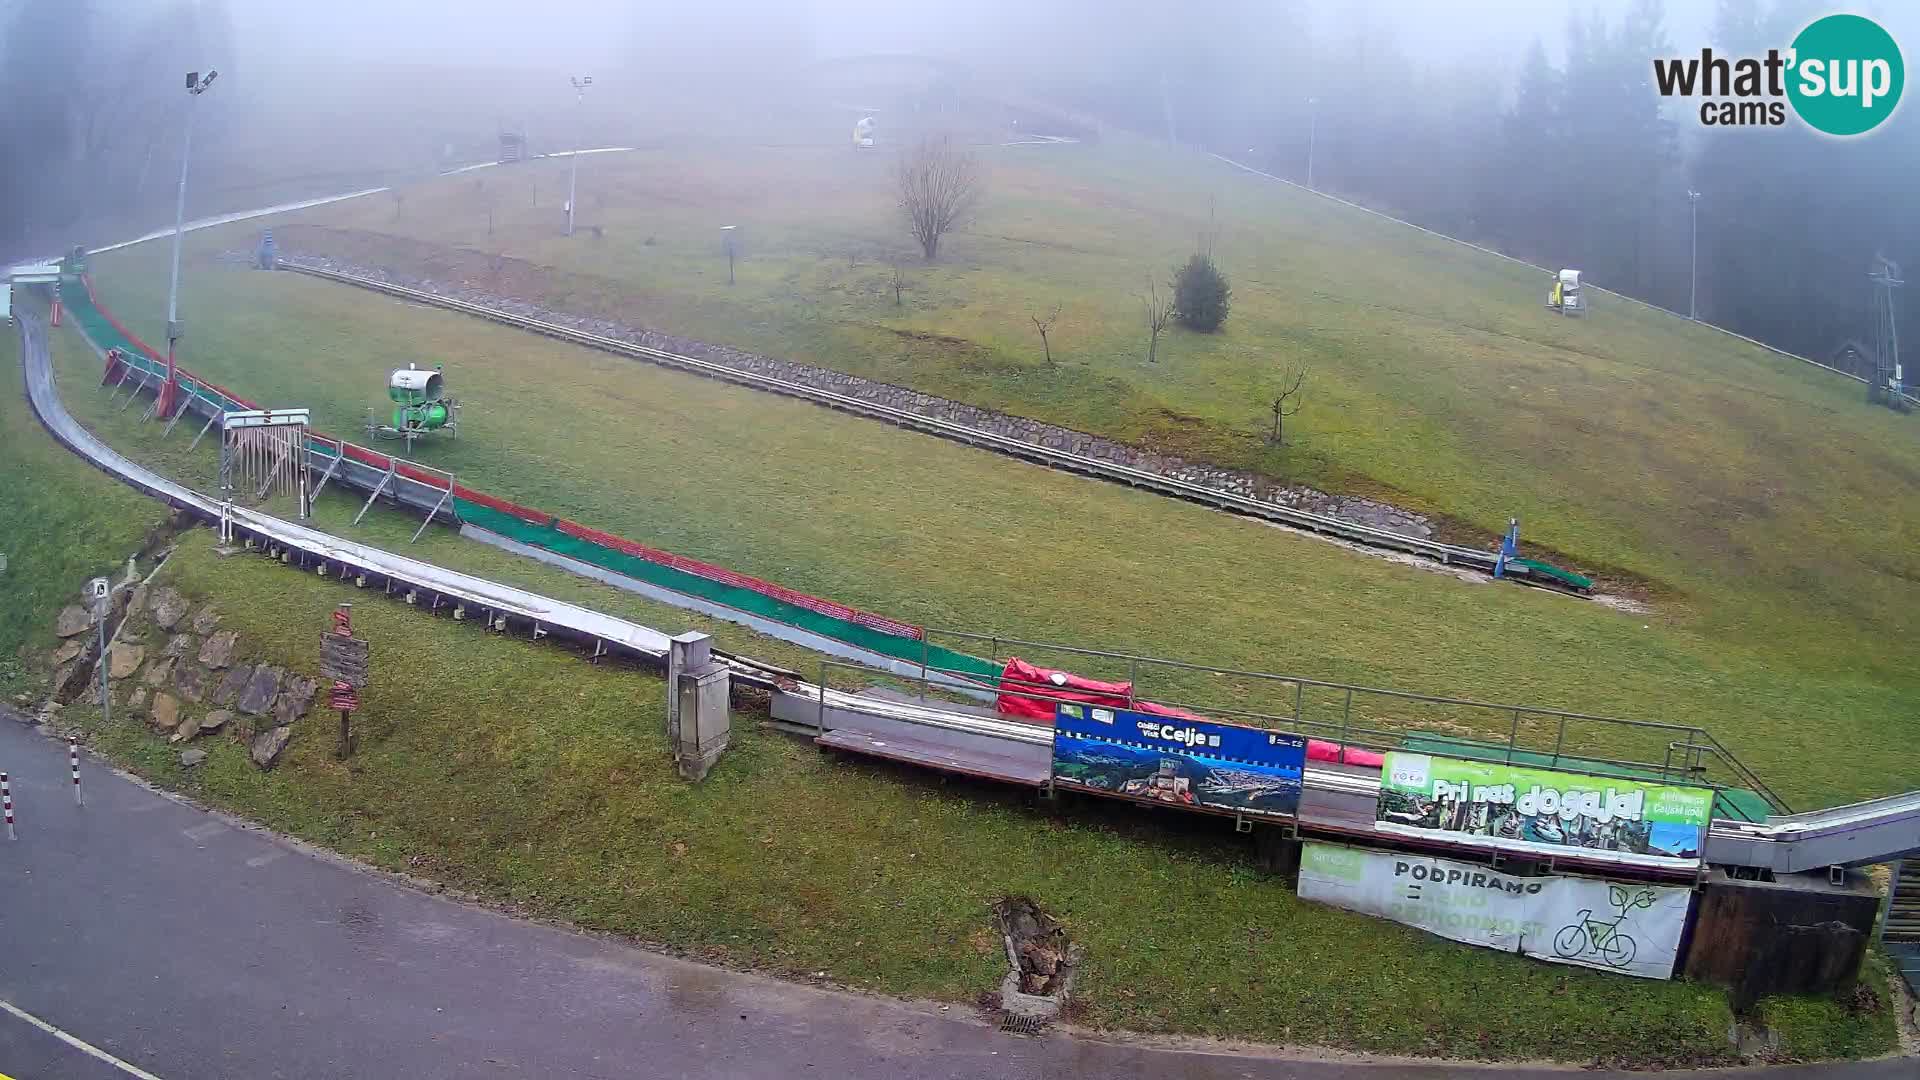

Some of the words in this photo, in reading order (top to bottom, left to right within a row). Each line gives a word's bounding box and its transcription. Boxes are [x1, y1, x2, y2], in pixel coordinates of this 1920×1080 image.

[1160, 725, 1206, 747] Celje
[1432, 779, 1470, 803] Pri
[1472, 782, 1515, 804] nas
[1516, 785, 1644, 824] dogaja!
[1395, 861, 1543, 894] PODPIRAMO
